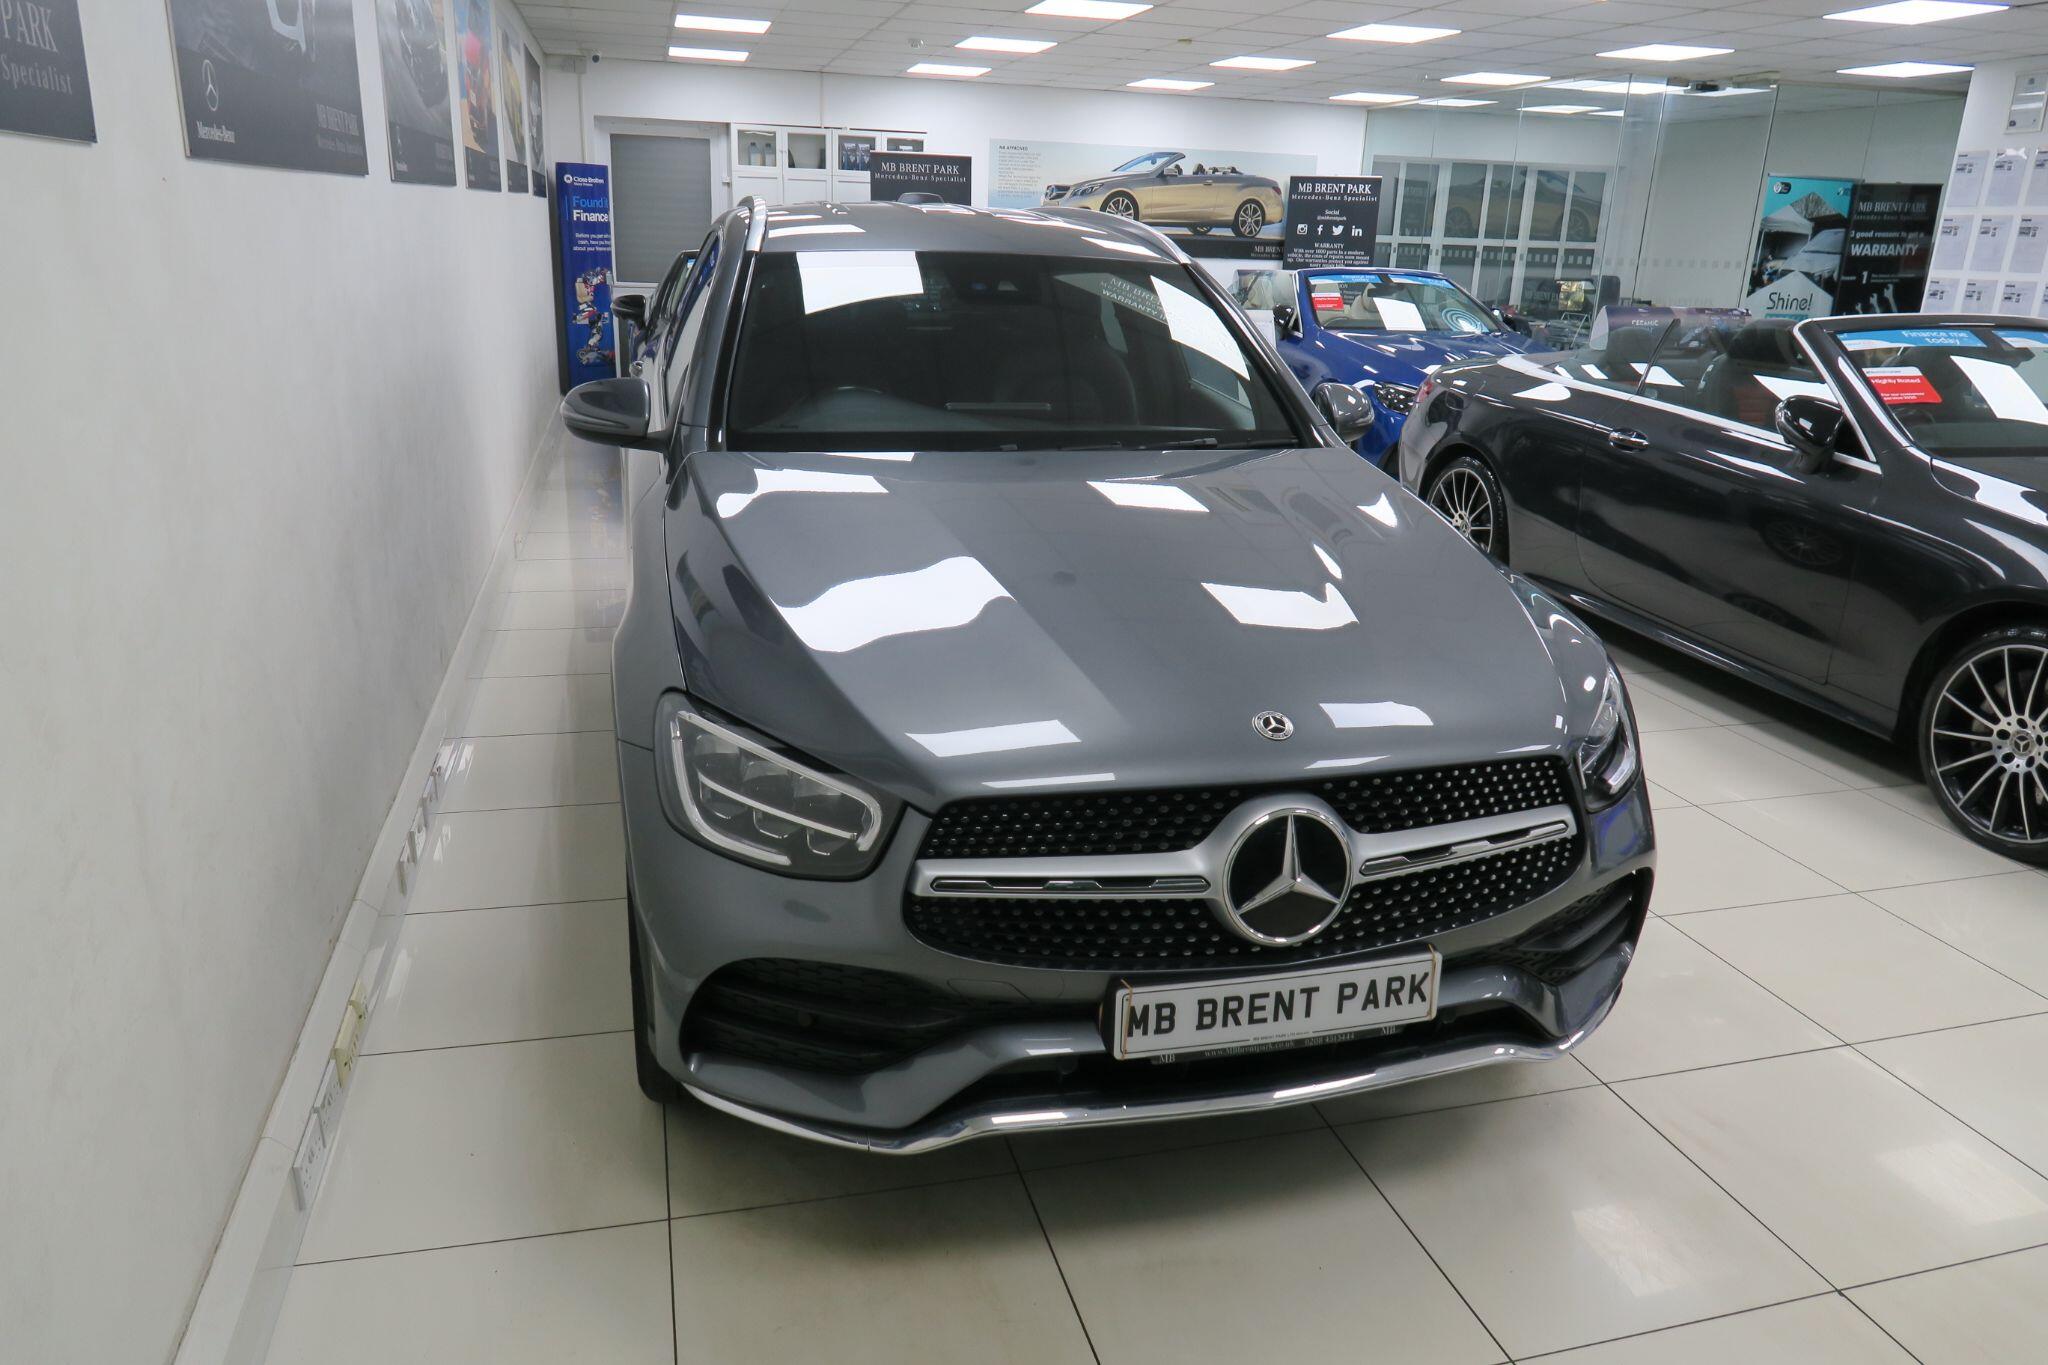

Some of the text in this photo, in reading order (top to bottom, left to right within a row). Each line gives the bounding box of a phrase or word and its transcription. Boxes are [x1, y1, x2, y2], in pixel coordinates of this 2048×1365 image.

[0, 0, 58, 52] PARK
[0, 54, 73, 95] Specialist
[881, 162, 960, 175] MB BRENT PARK
[931, 175, 967, 183] Specialist
[1298, 183, 1371, 194] MB BRENT PARK
[573, 195, 603, 208] Found
[1858, 202, 1927, 213] MB BRENT PARK
[573, 209, 609, 222] Finance
[1856, 230, 1874, 240] good
[1851, 243, 1920, 256] WARRANTY
[1102, 289, 1158, 316] WARRANTY
[1766, 292, 1813, 311] Shine!
[1902, 329, 1969, 339] Finance me
[1925, 336, 1960, 347] today
[1128, 972, 1430, 1038] MB BRENT PARK
[1159, 1053, 1176, 1065] MB
[1381, 1026, 1397, 1037] MB
